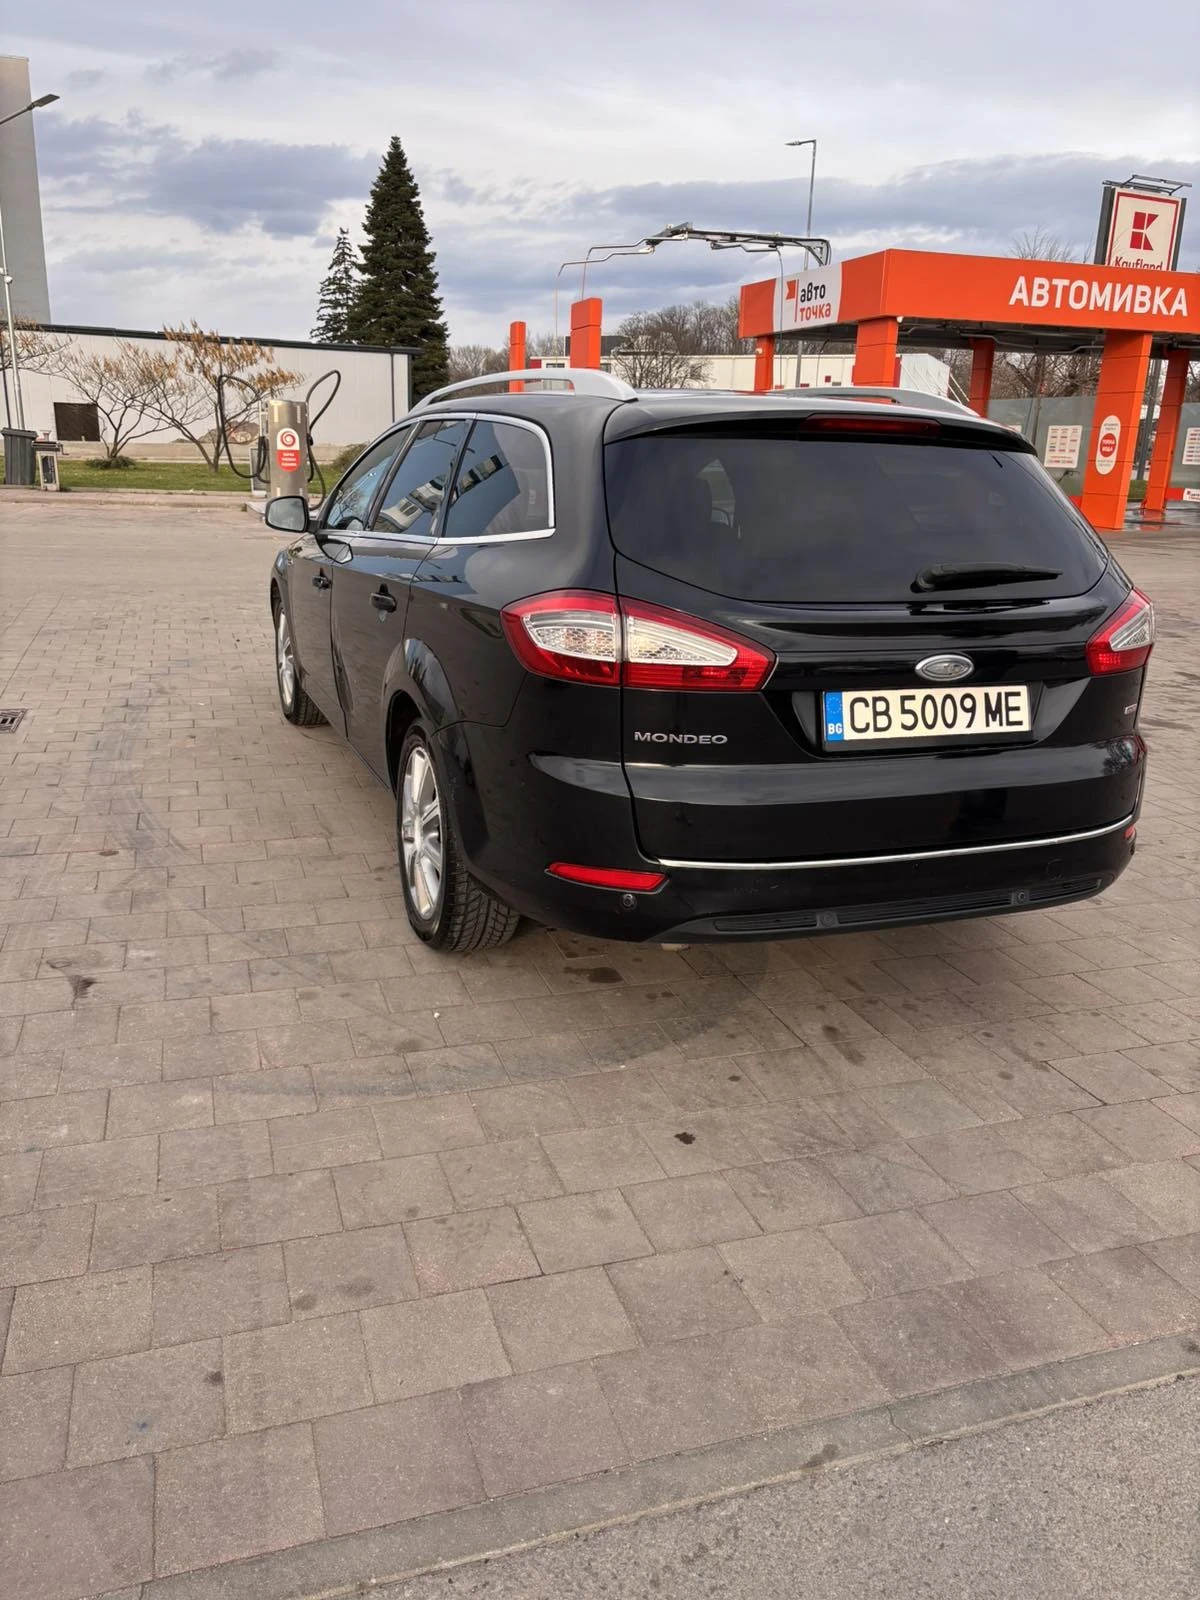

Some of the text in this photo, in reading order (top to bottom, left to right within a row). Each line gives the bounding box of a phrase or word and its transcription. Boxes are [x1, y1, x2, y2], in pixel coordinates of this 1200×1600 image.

[1130, 211, 1159, 251] K
[1114, 256, 1164, 271] Kaufland
[800, 282, 826, 303] авто
[1008, 275, 1189, 317] АВТОМИВКА
[800, 303, 831, 321] точка
[849, 691, 1024, 734] CB 5009 ME
[634, 731, 728, 744] MONDEO
[828, 723, 843, 735] BG
